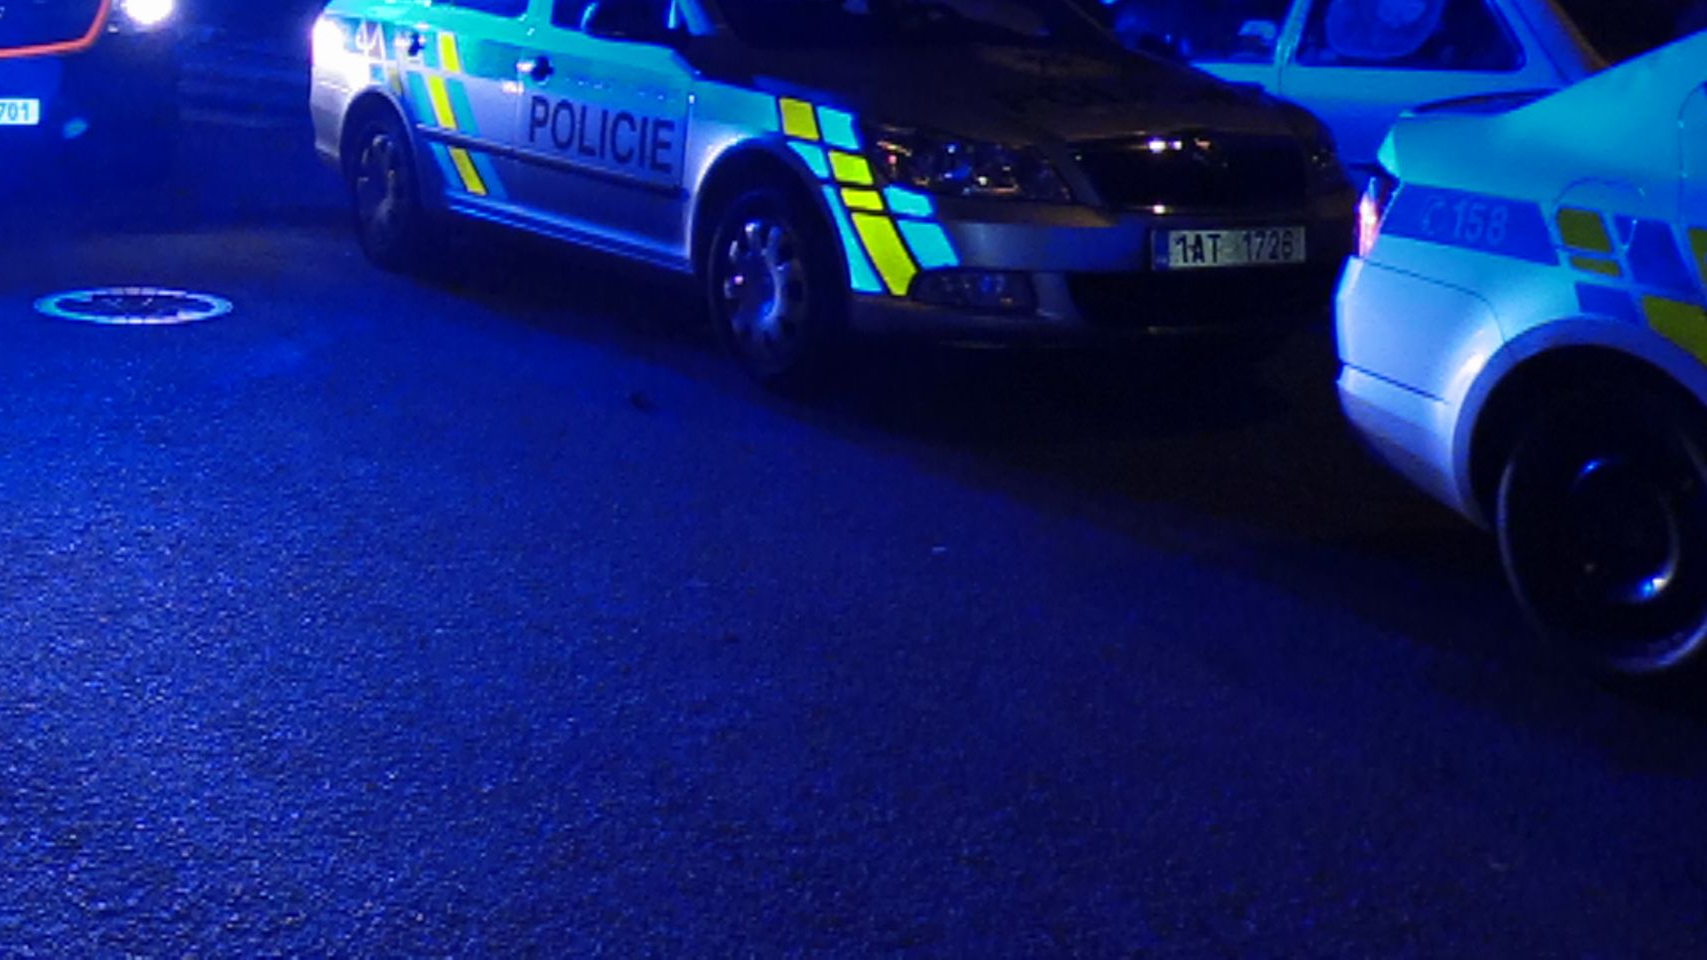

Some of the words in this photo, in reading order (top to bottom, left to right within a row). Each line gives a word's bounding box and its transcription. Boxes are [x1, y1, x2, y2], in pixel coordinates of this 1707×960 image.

[528, 95, 675, 173] POLICIE
[1454, 198, 1509, 246] 158
[1175, 233, 1222, 263] 1AT
